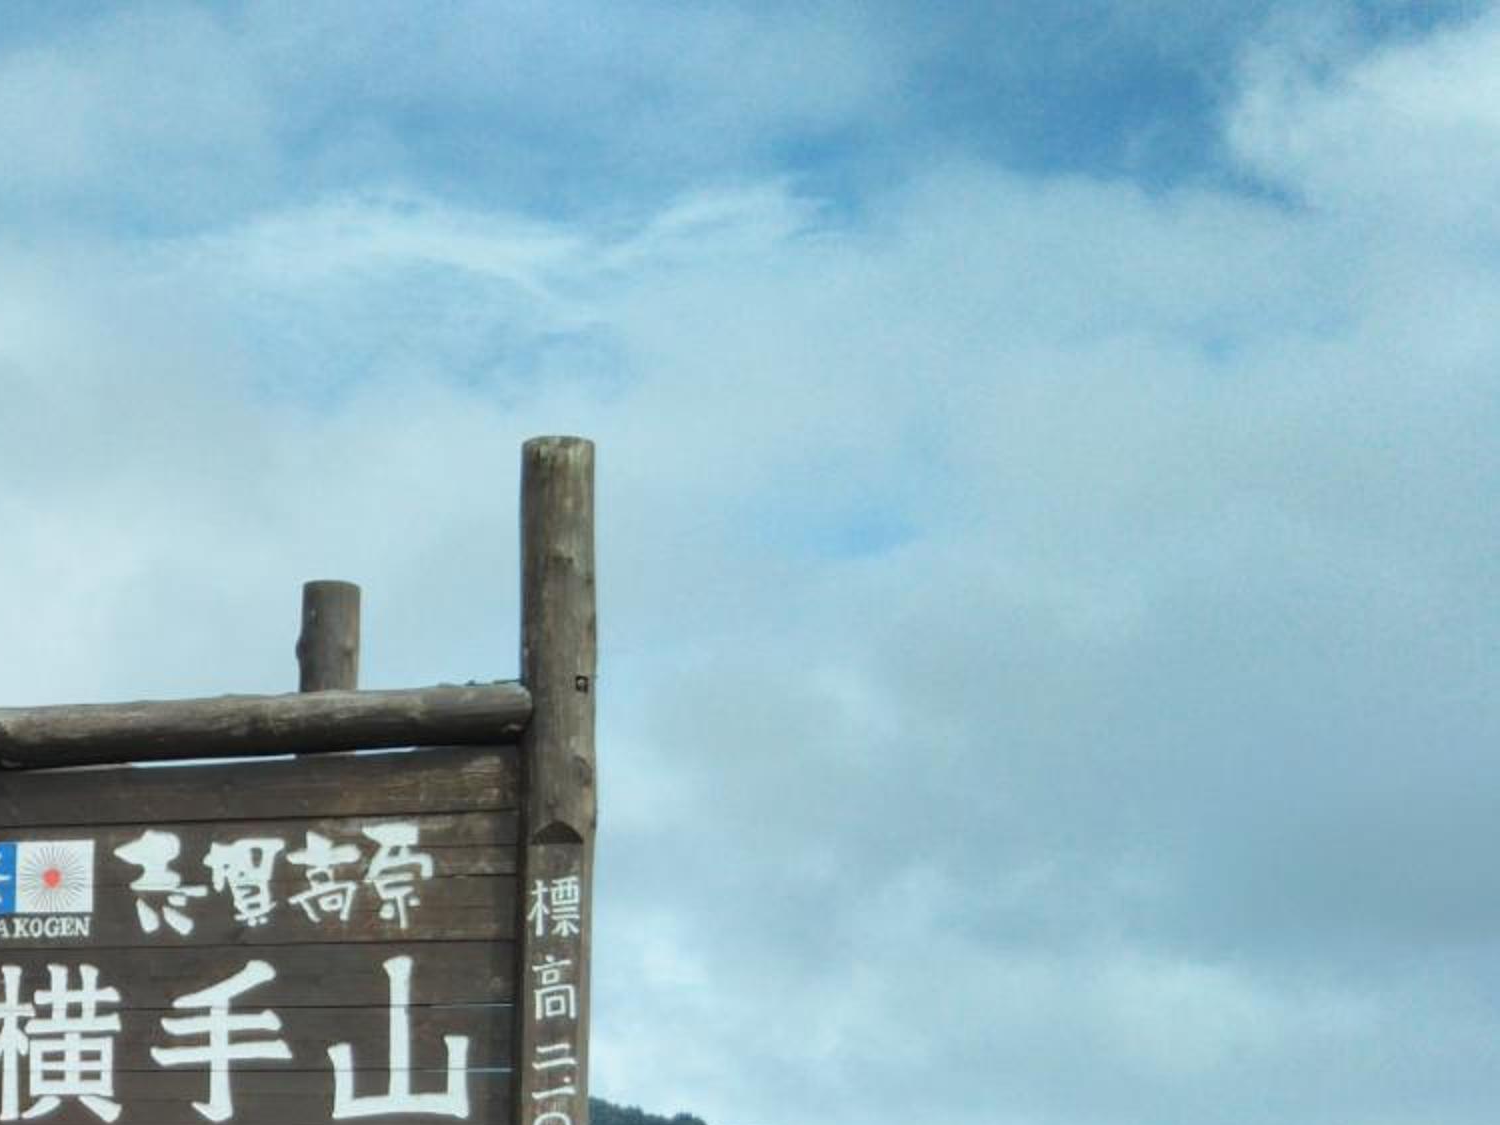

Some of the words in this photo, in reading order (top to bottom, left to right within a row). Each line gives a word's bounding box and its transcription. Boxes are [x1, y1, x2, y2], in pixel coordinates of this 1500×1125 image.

[113, 822, 434, 936] 志賀高原
[13, 916, 90, 937] KOGEN
